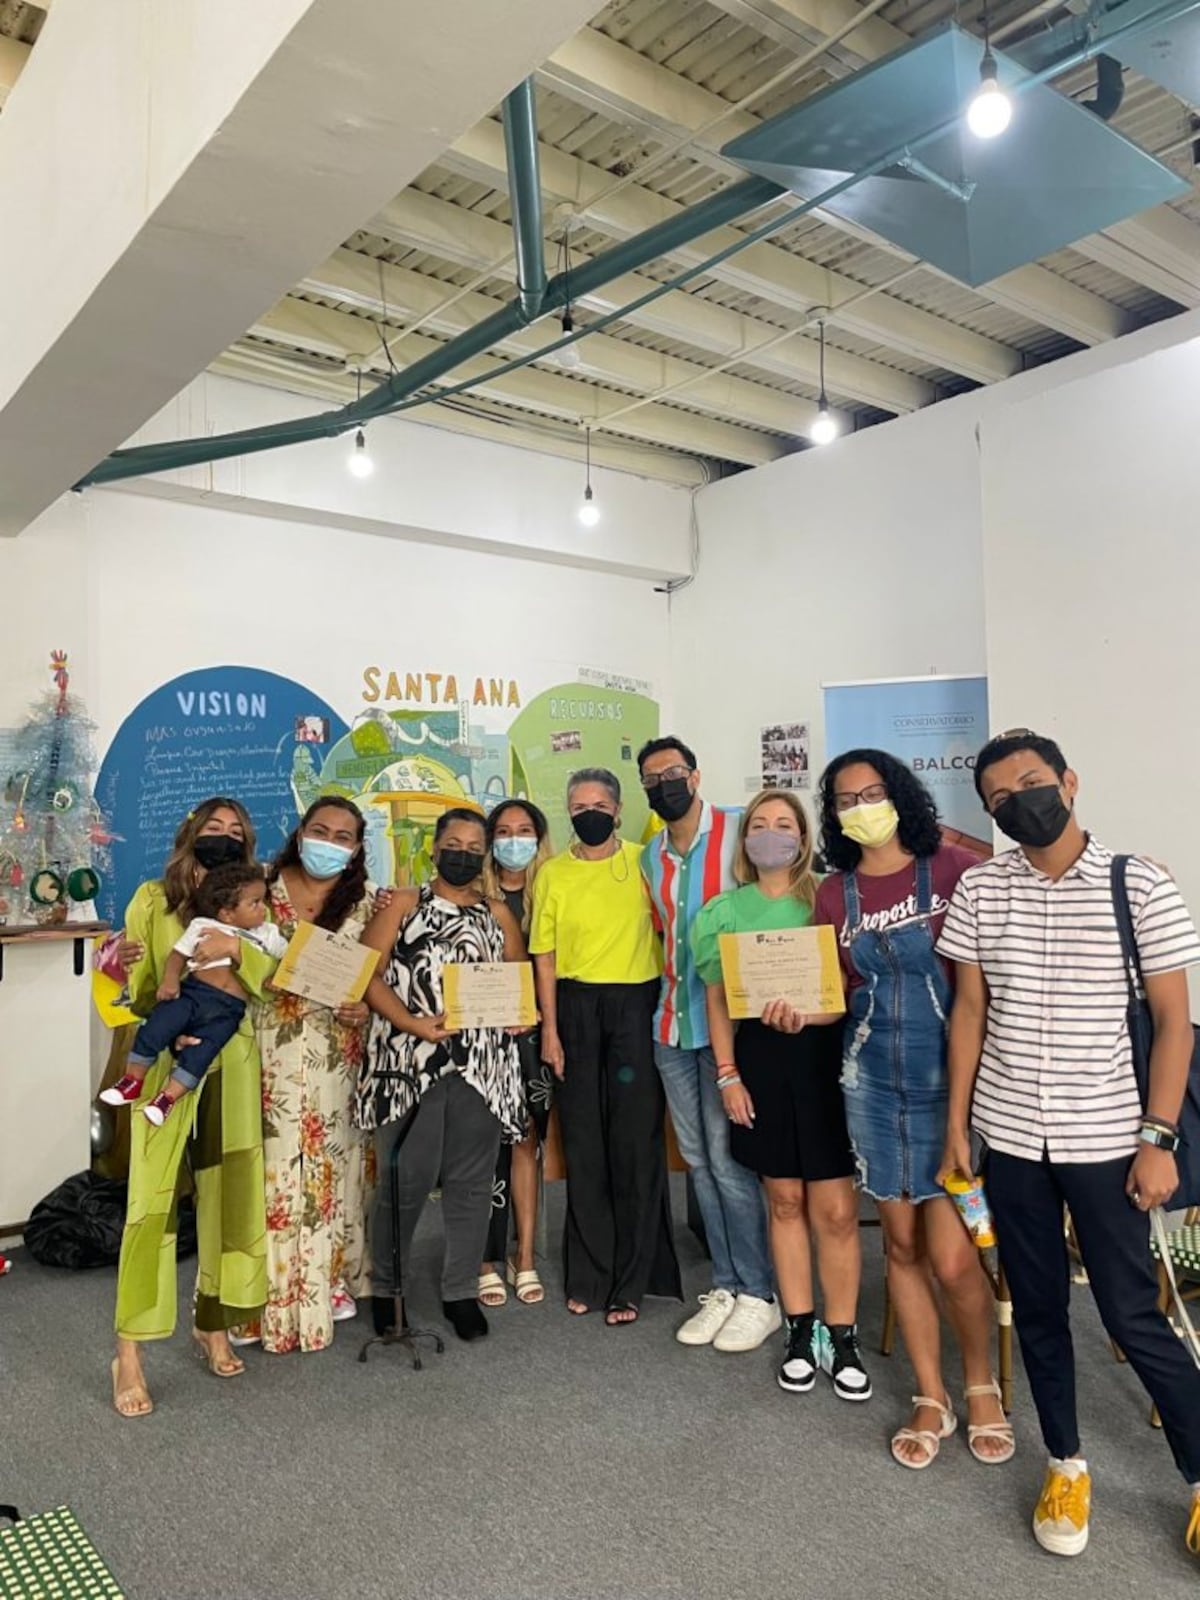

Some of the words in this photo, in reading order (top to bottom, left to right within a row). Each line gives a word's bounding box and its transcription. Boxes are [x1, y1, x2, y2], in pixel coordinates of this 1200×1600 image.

[362, 666, 458, 704] SANTA
[472, 677, 520, 708] ANA
[176, 691, 267, 719] VISION
[550, 698, 623, 721] RECURSOS
[893, 716, 977, 728] CONSERVATORIO
[839, 894, 949, 948] roposte
